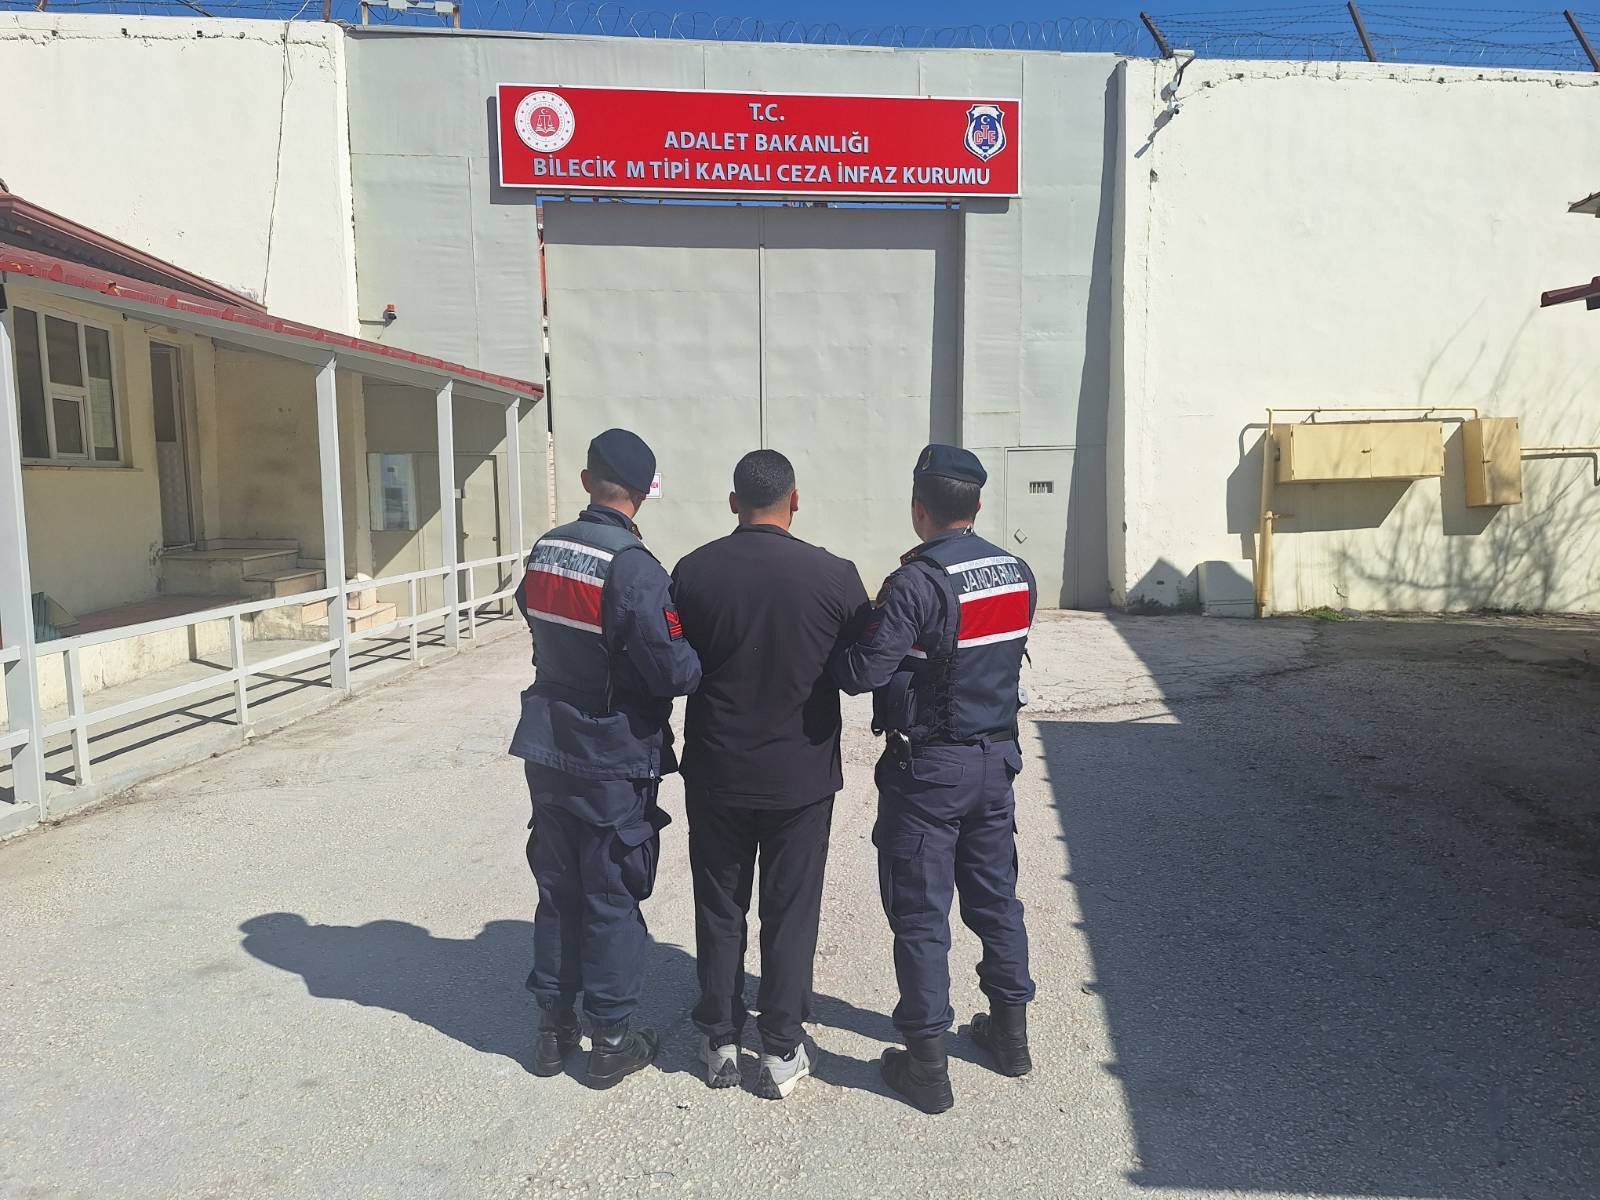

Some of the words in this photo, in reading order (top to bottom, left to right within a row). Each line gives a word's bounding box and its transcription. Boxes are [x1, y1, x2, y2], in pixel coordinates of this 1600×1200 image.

[749, 103, 785, 121] T.C.
[664, 131, 748, 151] ADALET
[755, 131, 869, 153] BAKANLIĞI
[533, 154, 616, 177] BİLECİK
[626, 160, 645, 179] M
[650, 158, 689, 180] TİPİ
[696, 162, 771, 182] KAPALI
[777, 164, 832, 183] CEZA
[837, 162, 898, 184] İNFAZ
[902, 166, 990, 185] KURUMU
[962, 563, 1023, 592] JANDARMA
